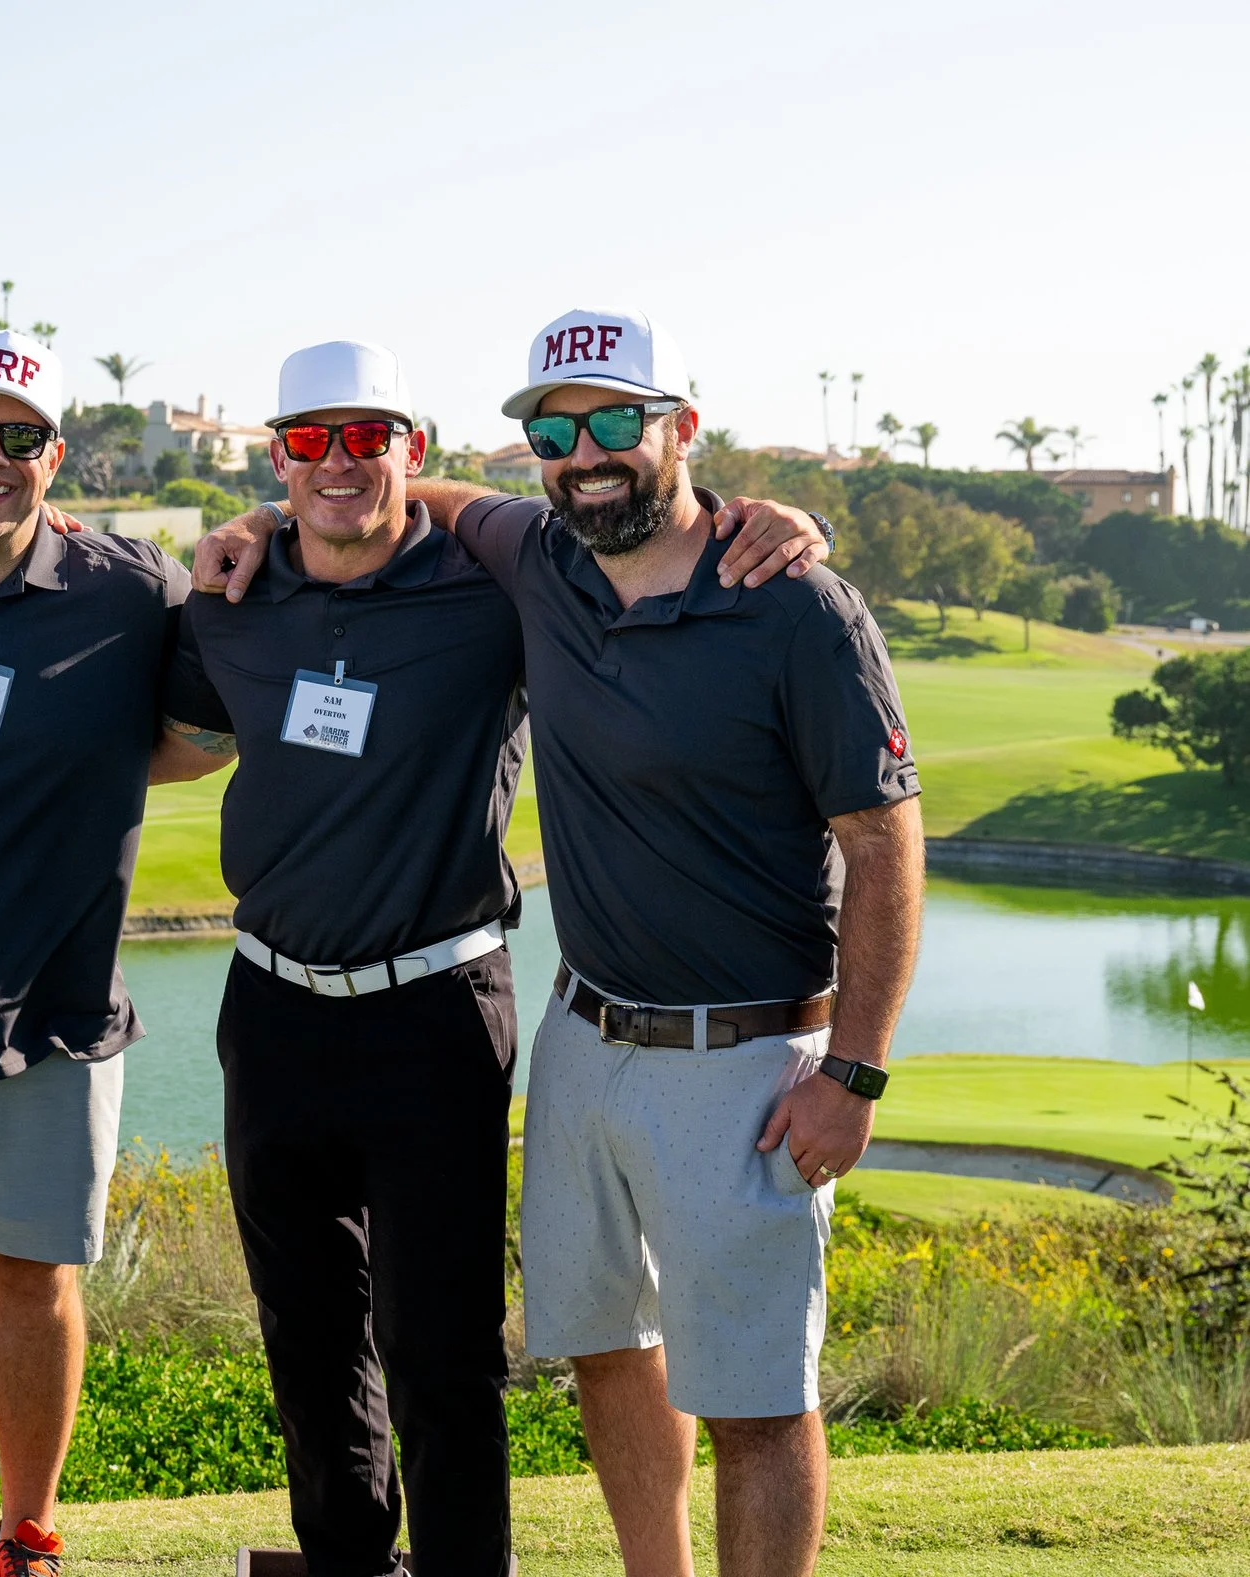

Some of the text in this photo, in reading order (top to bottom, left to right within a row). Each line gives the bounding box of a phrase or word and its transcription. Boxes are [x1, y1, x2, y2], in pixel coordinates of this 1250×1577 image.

[542, 325, 622, 372] MRF
[323, 695, 343, 706] SAM
[314, 708, 347, 720] OVERTON
[321, 726, 350, 738] MARINE
[319, 733, 348, 746] RAIDER
